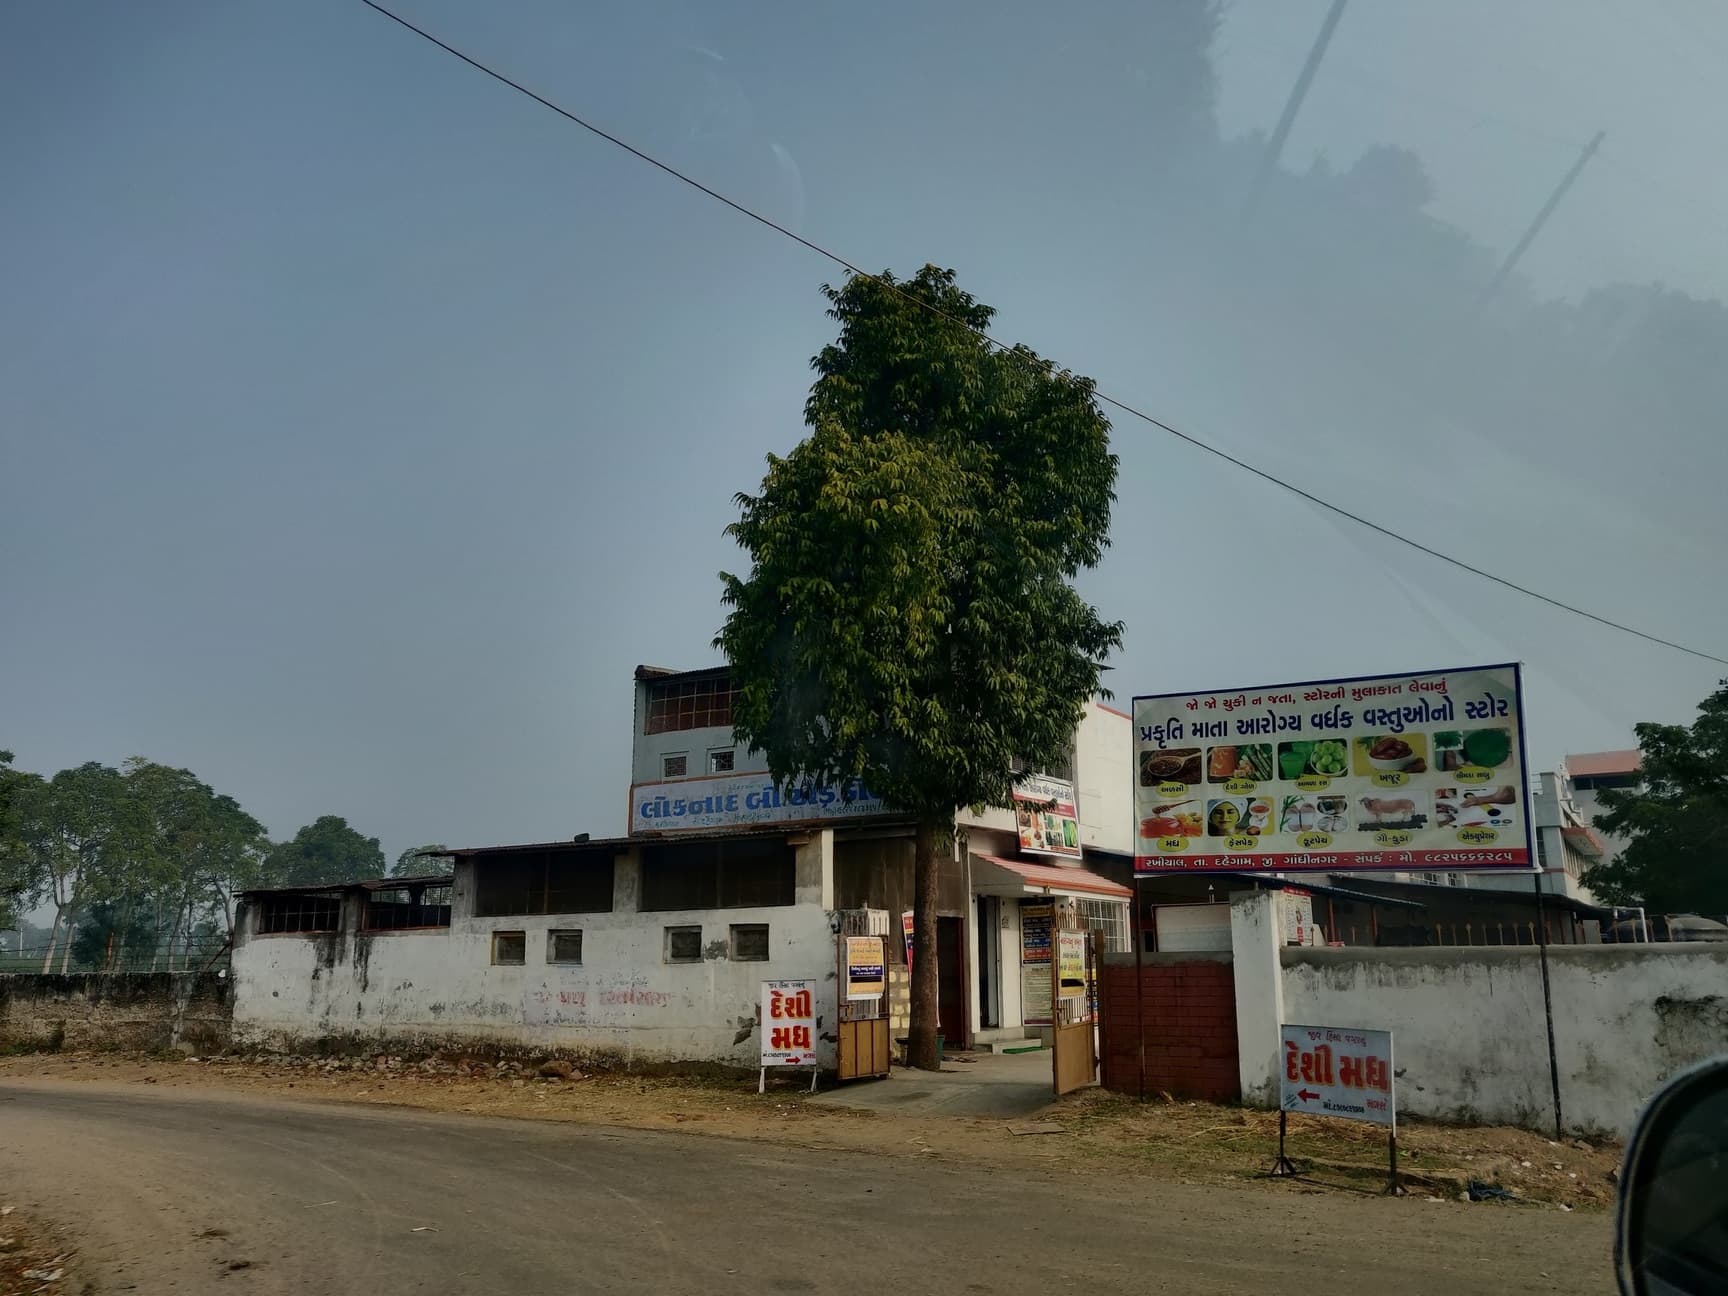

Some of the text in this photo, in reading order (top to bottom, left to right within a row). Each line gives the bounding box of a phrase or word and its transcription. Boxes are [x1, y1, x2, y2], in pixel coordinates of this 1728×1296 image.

[1187, 698, 1198, 710] જો
[1205, 698, 1216, 709] જો
[1252, 697, 1262, 705] ન
[1268, 693, 1296, 705] જતા,
[1304, 686, 1345, 702] સ્ટોરની
[1352, 685, 1402, 701] મુલાકાત
[1409, 677, 1447, 694] લેવાનું
[1140, 692, 1508, 749] પ્રકૃતિ માતા આરોગ્ય વર્ધક વસ્તુઓનો સ્ટોર
[1165, 839, 1180, 847] મધ
[1145, 856, 1187, 868] રખીયાલ,
[1193, 857, 1208, 866] તા.
[1215, 857, 1255, 866] દહેગામ,
[1262, 857, 1276, 867] જી.
[1283, 854, 1338, 865] ગાંધીનગર
[1355, 852, 1384, 863] સંપર્ક
[1400, 851, 1416, 862] મો.
[770, 990, 811, 1018] દેશી
[771, 1026, 810, 1049] મધ
[1285, 1040, 1388, 1091] દેશી મધ
